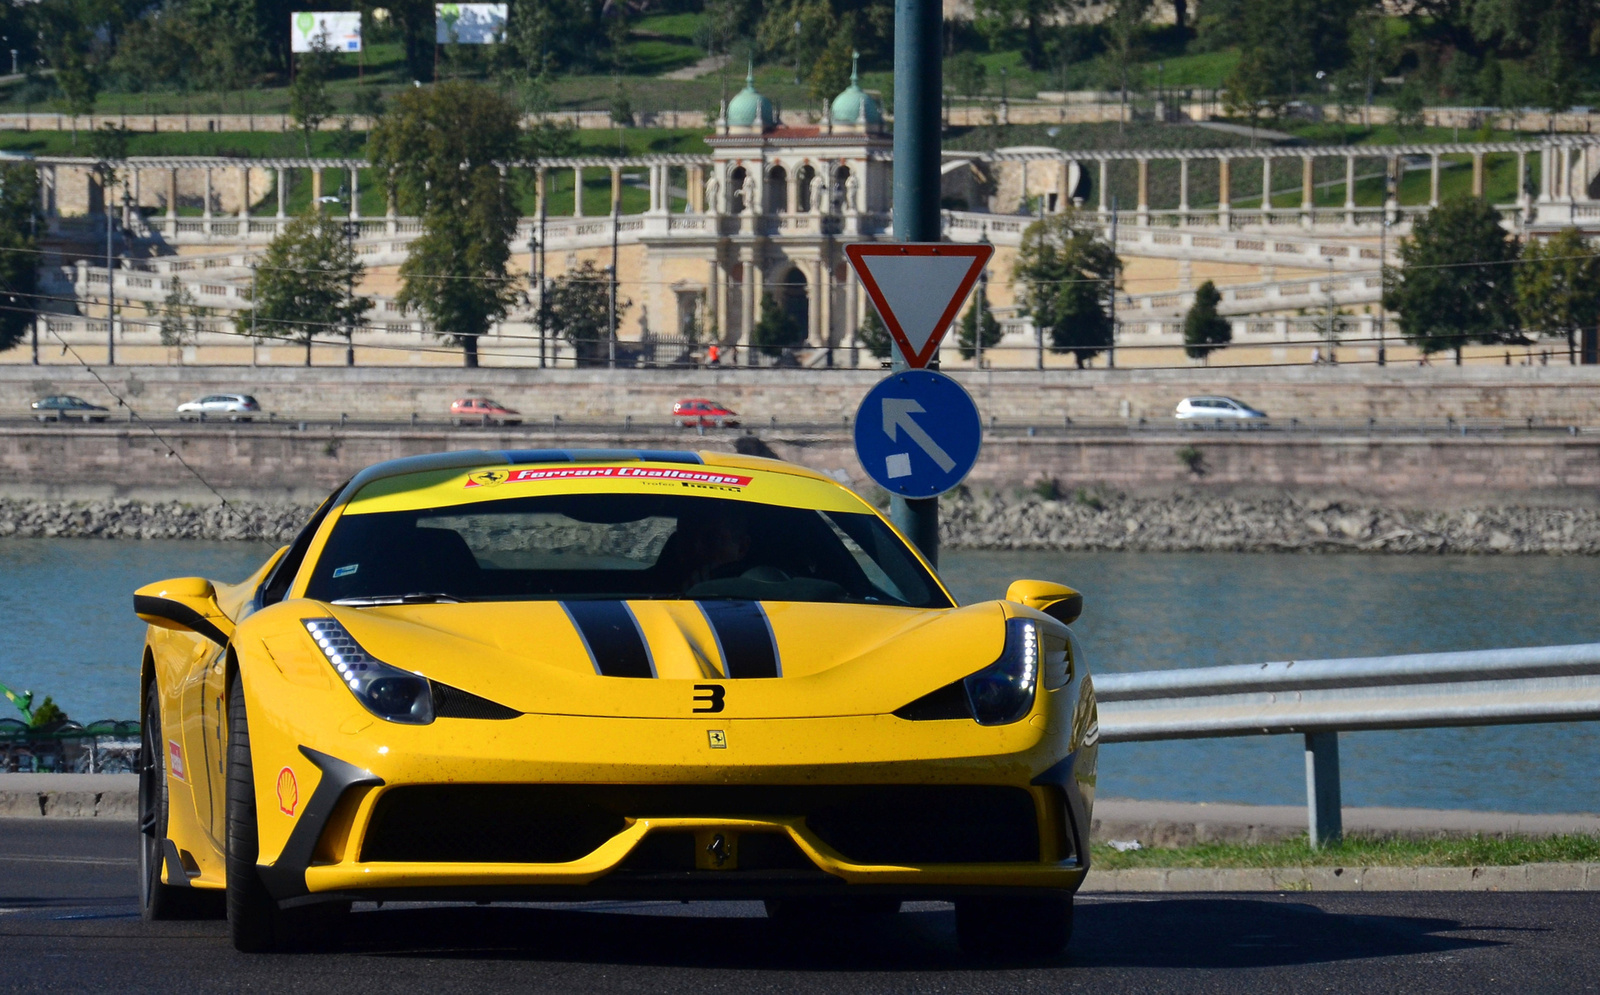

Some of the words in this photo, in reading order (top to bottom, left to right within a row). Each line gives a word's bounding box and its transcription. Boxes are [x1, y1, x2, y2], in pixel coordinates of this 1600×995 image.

[517, 468, 613, 479] Ferrari
[618, 467, 739, 483] Challenge
[692, 684, 726, 713] 3
